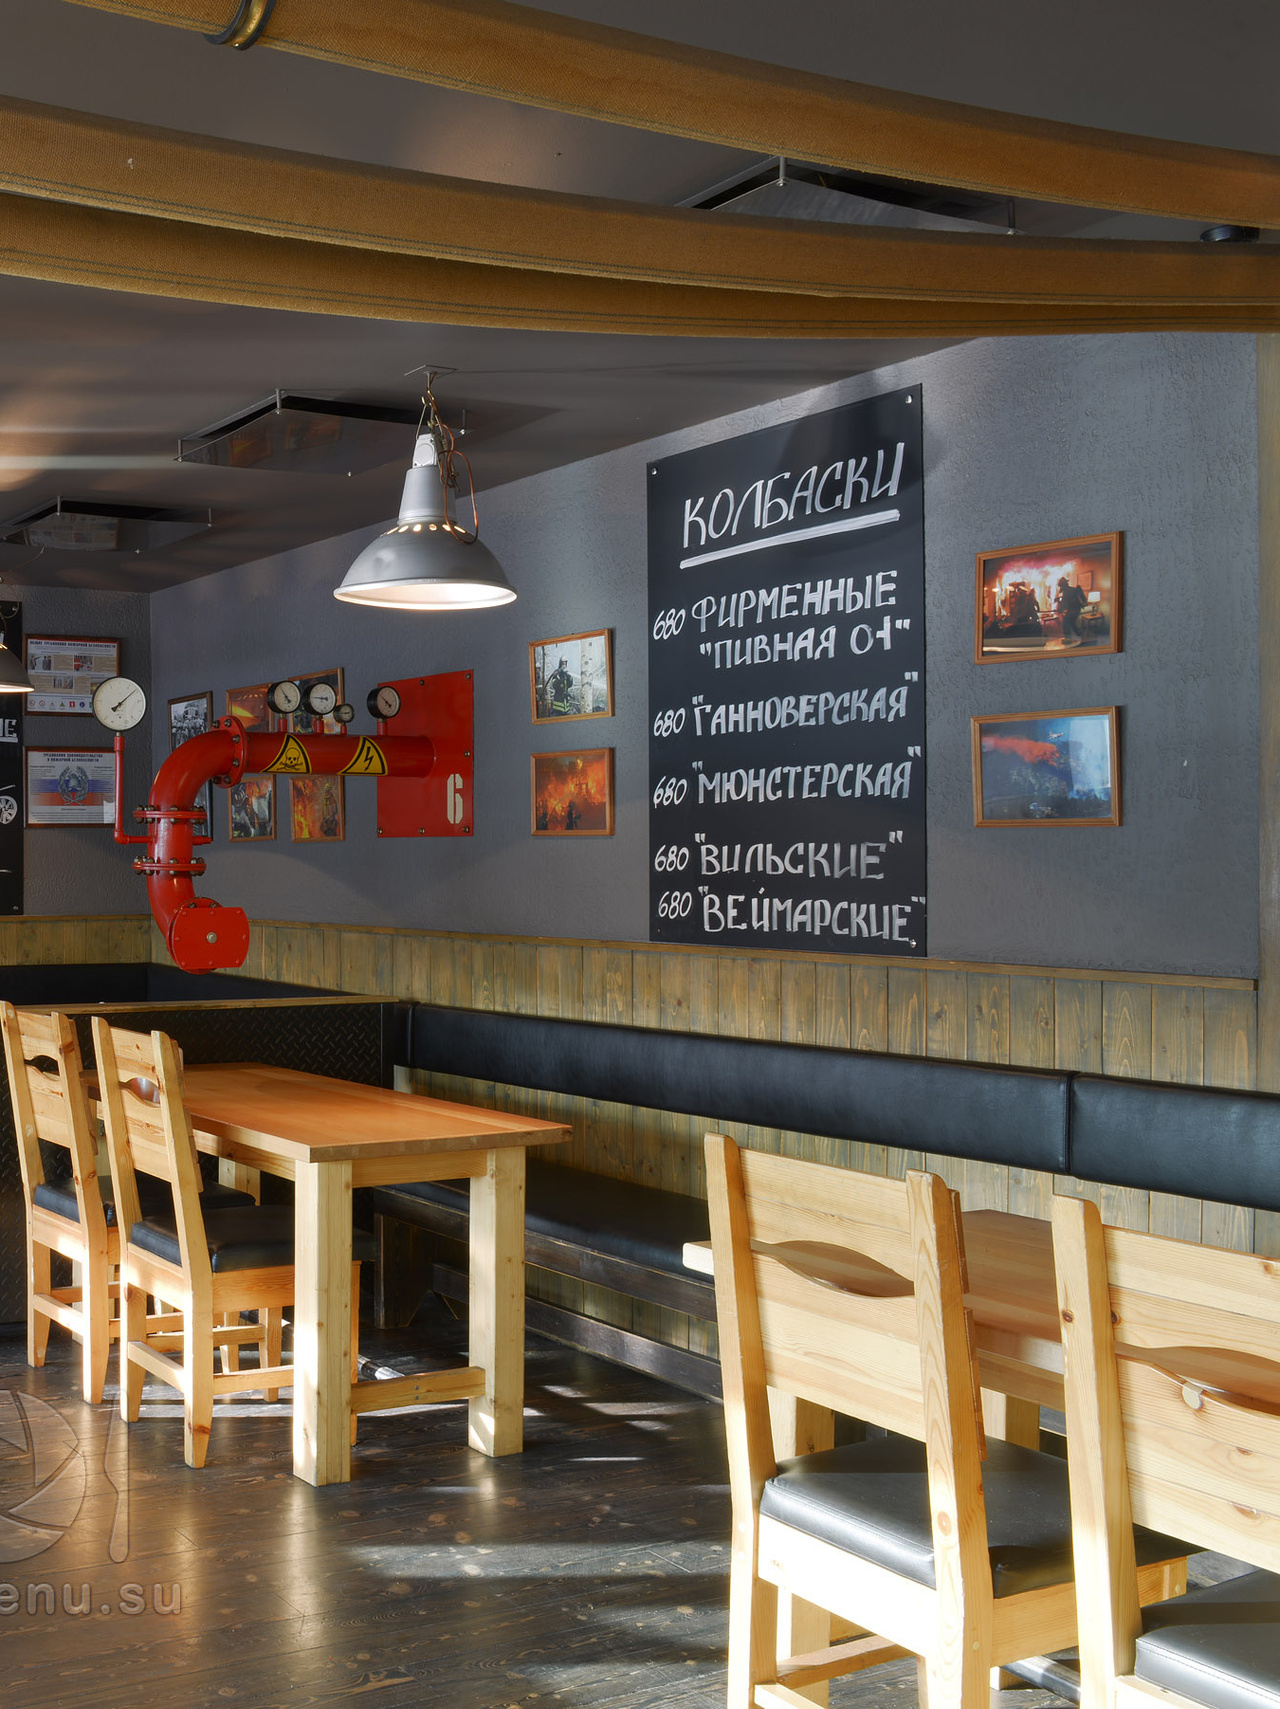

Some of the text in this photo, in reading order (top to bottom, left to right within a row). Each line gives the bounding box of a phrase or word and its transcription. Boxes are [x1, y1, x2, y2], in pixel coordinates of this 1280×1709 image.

[683, 442, 904, 548] КОЛБАСКИ
[653, 570, 898, 640] 680 ФИРМЕННЫЕ
[653, 707, 686, 738] 680
[446, 773, 464, 824] 6
[653, 776, 688, 808] 680
[654, 844, 690, 872] 680
[658, 890, 693, 920] 680
